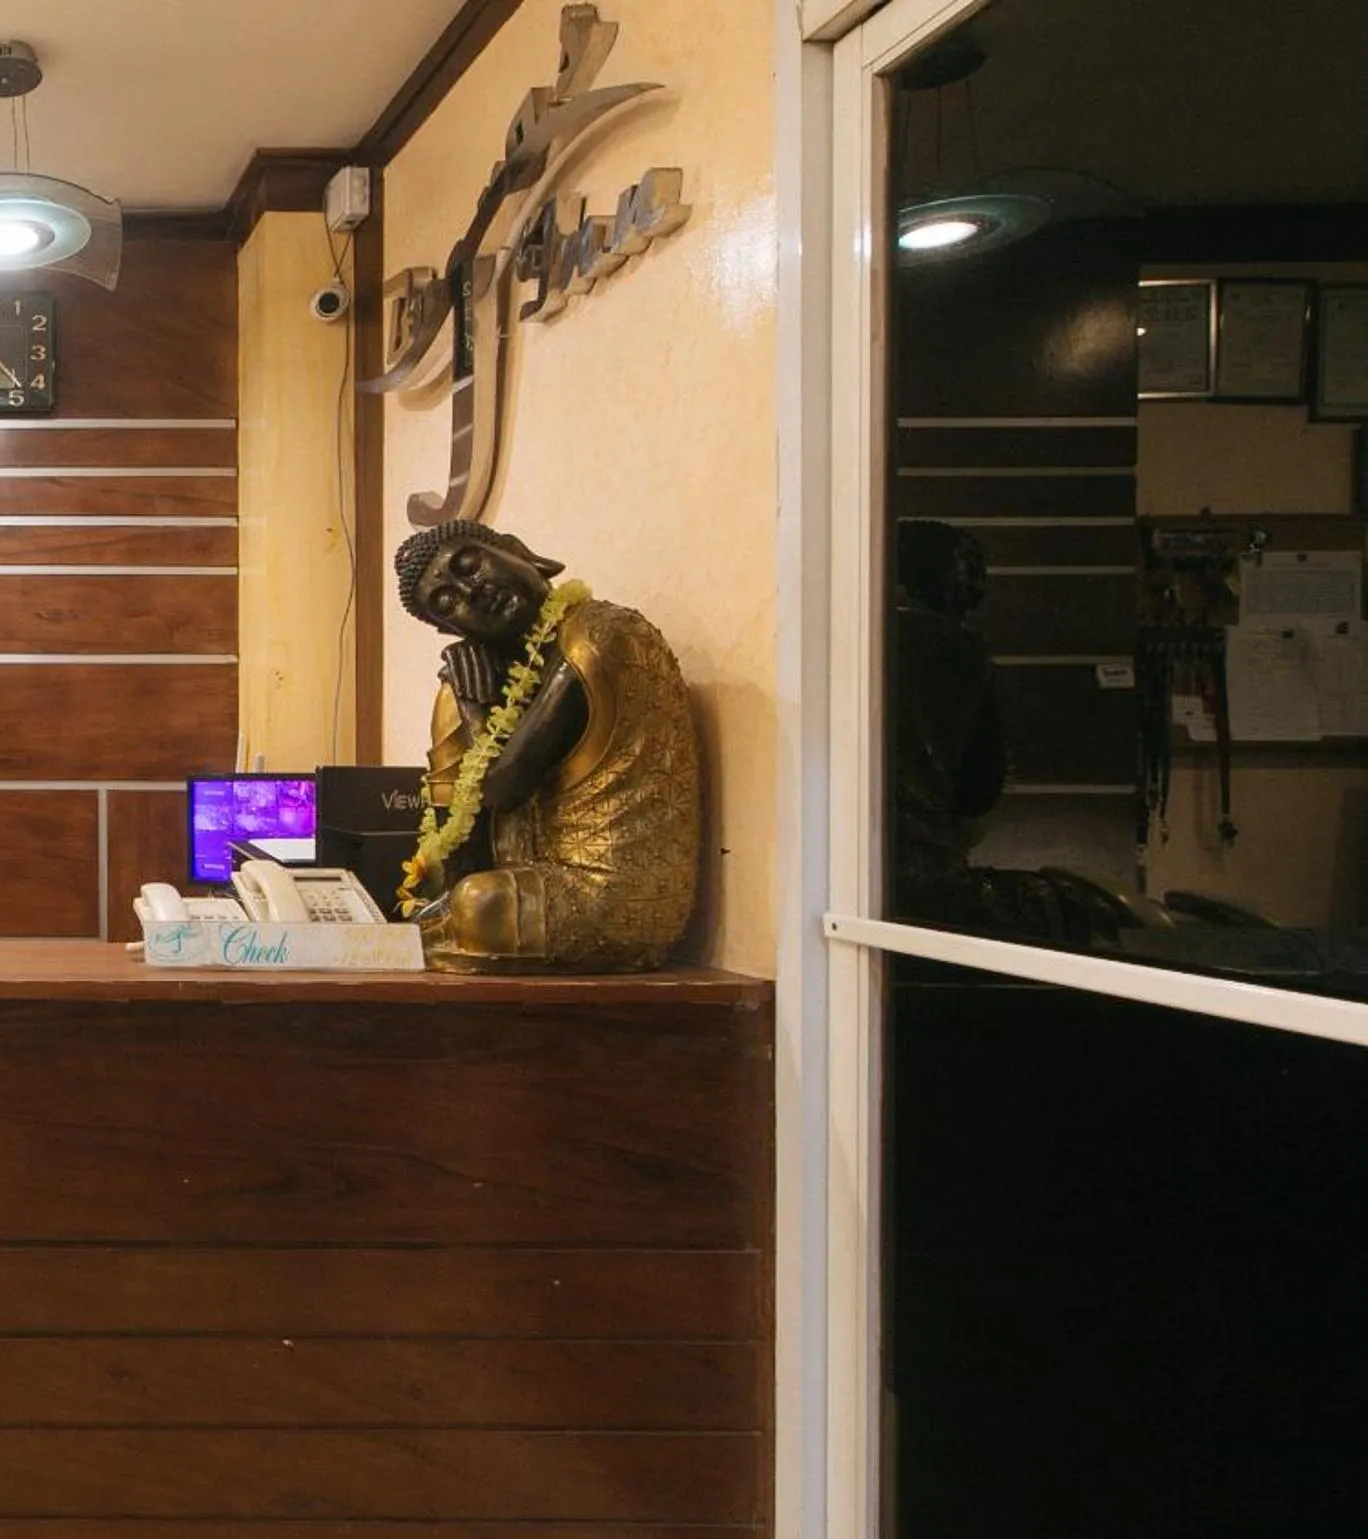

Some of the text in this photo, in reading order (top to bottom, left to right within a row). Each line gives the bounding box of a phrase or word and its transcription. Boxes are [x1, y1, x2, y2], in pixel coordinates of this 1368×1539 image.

[13, 300, 21, 316] 1
[31, 314, 47, 331] 2
[30, 344, 46, 361] 3
[30, 373, 45, 390] 4
[8, 389, 25, 407] 5
